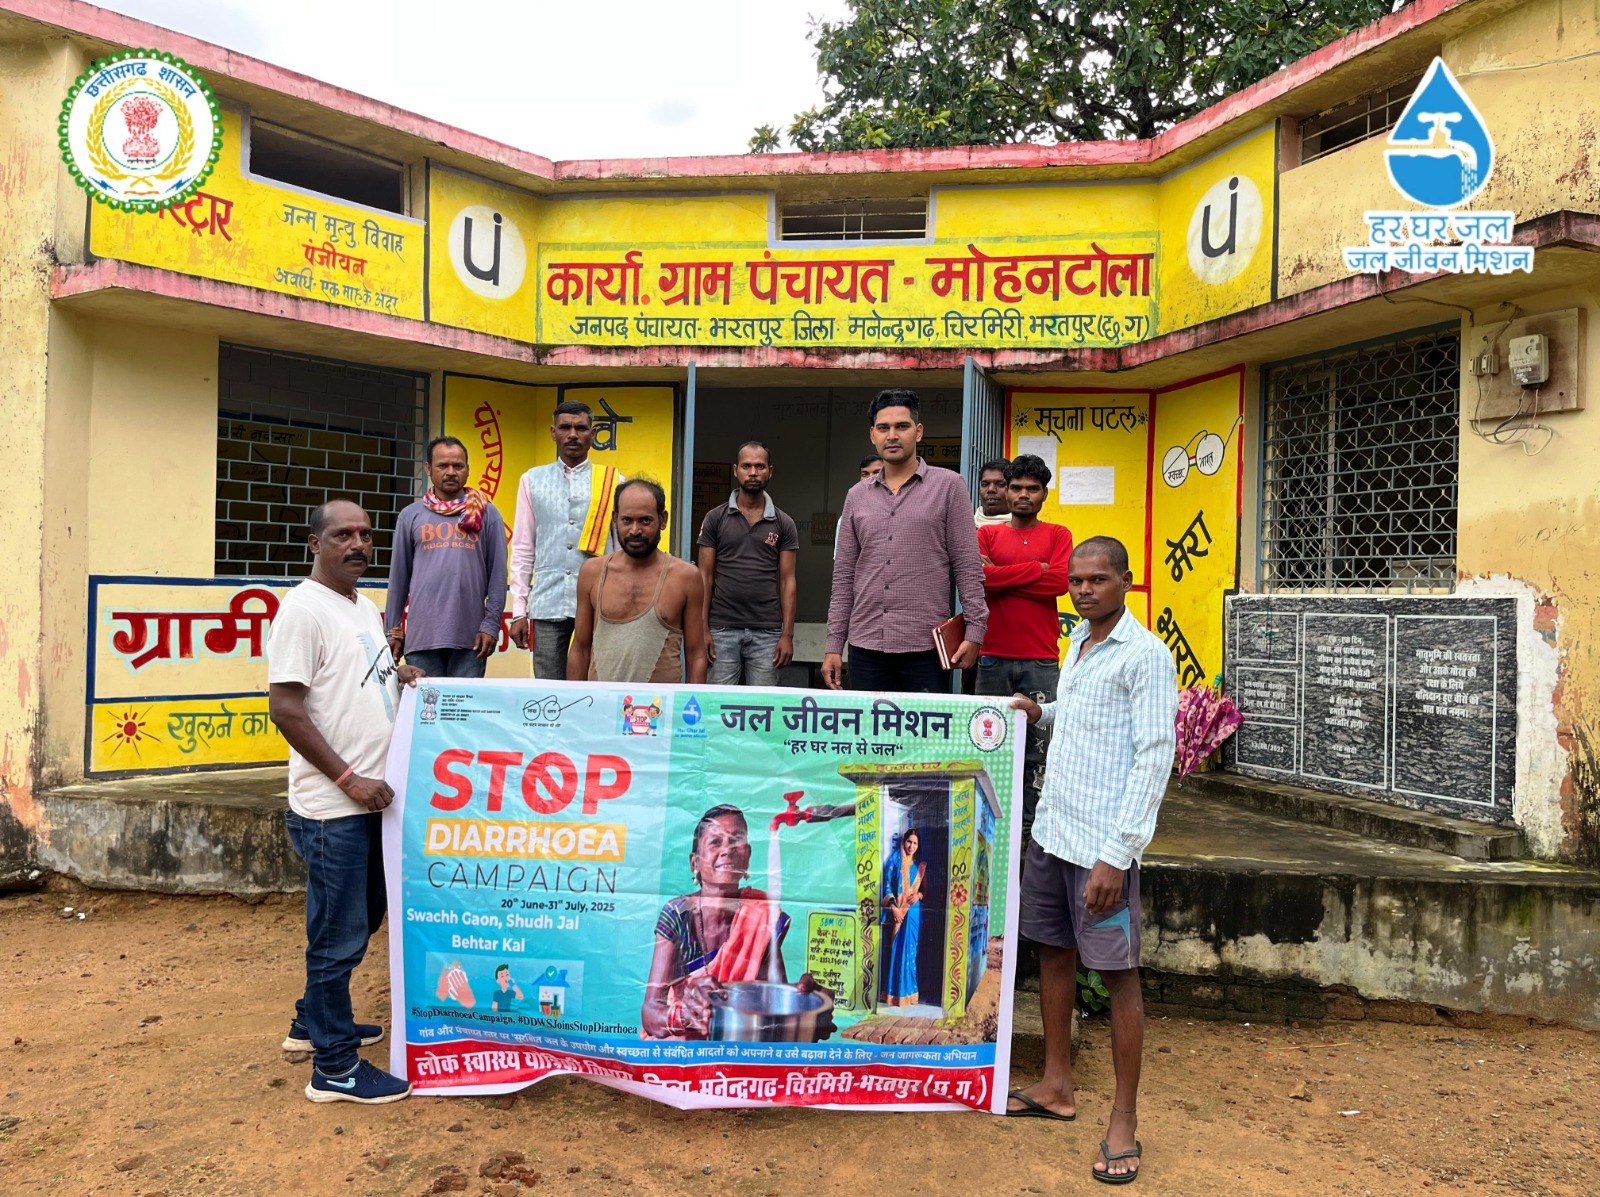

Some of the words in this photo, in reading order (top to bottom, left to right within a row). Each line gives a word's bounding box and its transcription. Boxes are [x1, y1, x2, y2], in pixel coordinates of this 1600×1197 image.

[276, 204, 317, 231] जन्म
[323, 215, 356, 248] मृत्यु
[362, 219, 405, 262] विवाह
[302, 238, 368, 277] पंजीयन
[659, 262, 733, 307] ग्राम
[745, 250, 895, 305] पंचायत
[925, 242, 1154, 304] मोहनटोला
[320, 280, 340, 302] एक
[569, 316, 628, 340] जनपद
[709, 316, 785, 346] भरतपुर
[1034, 407, 1087, 443] सूचना
[1089, 406, 1136, 434] पटल
[474, 401, 502, 500] पंचायत
[1199, 452, 1214, 468] भारत
[424, 542, 450, 551] HUGO
[451, 541, 476, 550] BOSS
[1164, 509, 1213, 582] मेरा
[1157, 607, 1206, 689] भारत
[1415, 649, 1442, 662] मातृभूमि
[1443, 650, 1452, 660] की
[1440, 677, 1447, 688] के
[1448, 678, 1464, 690] लिये
[1467, 667, 1477, 678] की
[1415, 689, 1441, 701] बलिदान
[1469, 694, 1479, 705] को
[167, 703, 238, 754] खुलने
[721, 704, 774, 732] जल
[782, 696, 863, 735] जीवन
[872, 699, 953, 739] मिशन
[810, 741, 828, 754] घर
[831, 742, 853, 754] नल
[856, 738, 868, 755] से
[429, 748, 632, 815] STOP
[428, 823, 620, 857] DIARRHOEA
[427, 861, 617, 894] CAMPAIGN
[406, 908, 458, 924] Swachh
[462, 911, 502, 929] Gaon,
[506, 912, 553, 929] Shudh
[557, 914, 579, 930] Jal
[501, 898, 518, 909] 20th
[566, 901, 588, 912] July,
[591, 902, 615, 912] 2025
[452, 935, 498, 951] Behtar
[502, 937, 525, 952] Kal
[412, 1007, 515, 1025] #StopDiarrhoeaCampaign,
[518, 1015, 638, 1034] #DDWSJoinsStopDiarrhoea
[419, 1026, 434, 1038] गांव
[437, 1024, 453, 1035] और
[499, 1032, 510, 1040] पर
[544, 1036, 559, 1046] जल
[560, 1038, 568, 1048] के
[570, 1041, 596, 1052] उपयोग
[599, 1043, 614, 1054] और
[616, 1046, 651, 1058] स्वच्छता
[652, 1045, 661, 1057] से
[663, 1045, 694, 1058] संबंधित
[696, 1045, 724, 1057] आदतों
[726, 1045, 739, 1057] को
[741, 1046, 774, 1058] अपनाने
[775, 1049, 782, 1058] व
[784, 1046, 799, 1058] उसे
[801, 1049, 827, 1061] बढ़ावा
[829, 1047, 841, 1060] देने
[844, 1048, 853, 1059] के
[855, 1049, 873, 1061] लिए
[880, 1050, 895, 1059] जन
[897, 1051, 941, 1061] जागरूकता
[943, 1049, 977, 1061] अभियान
[415, 1051, 459, 1076] लोक
[462, 1050, 520, 1073] स्वास्थ्य
